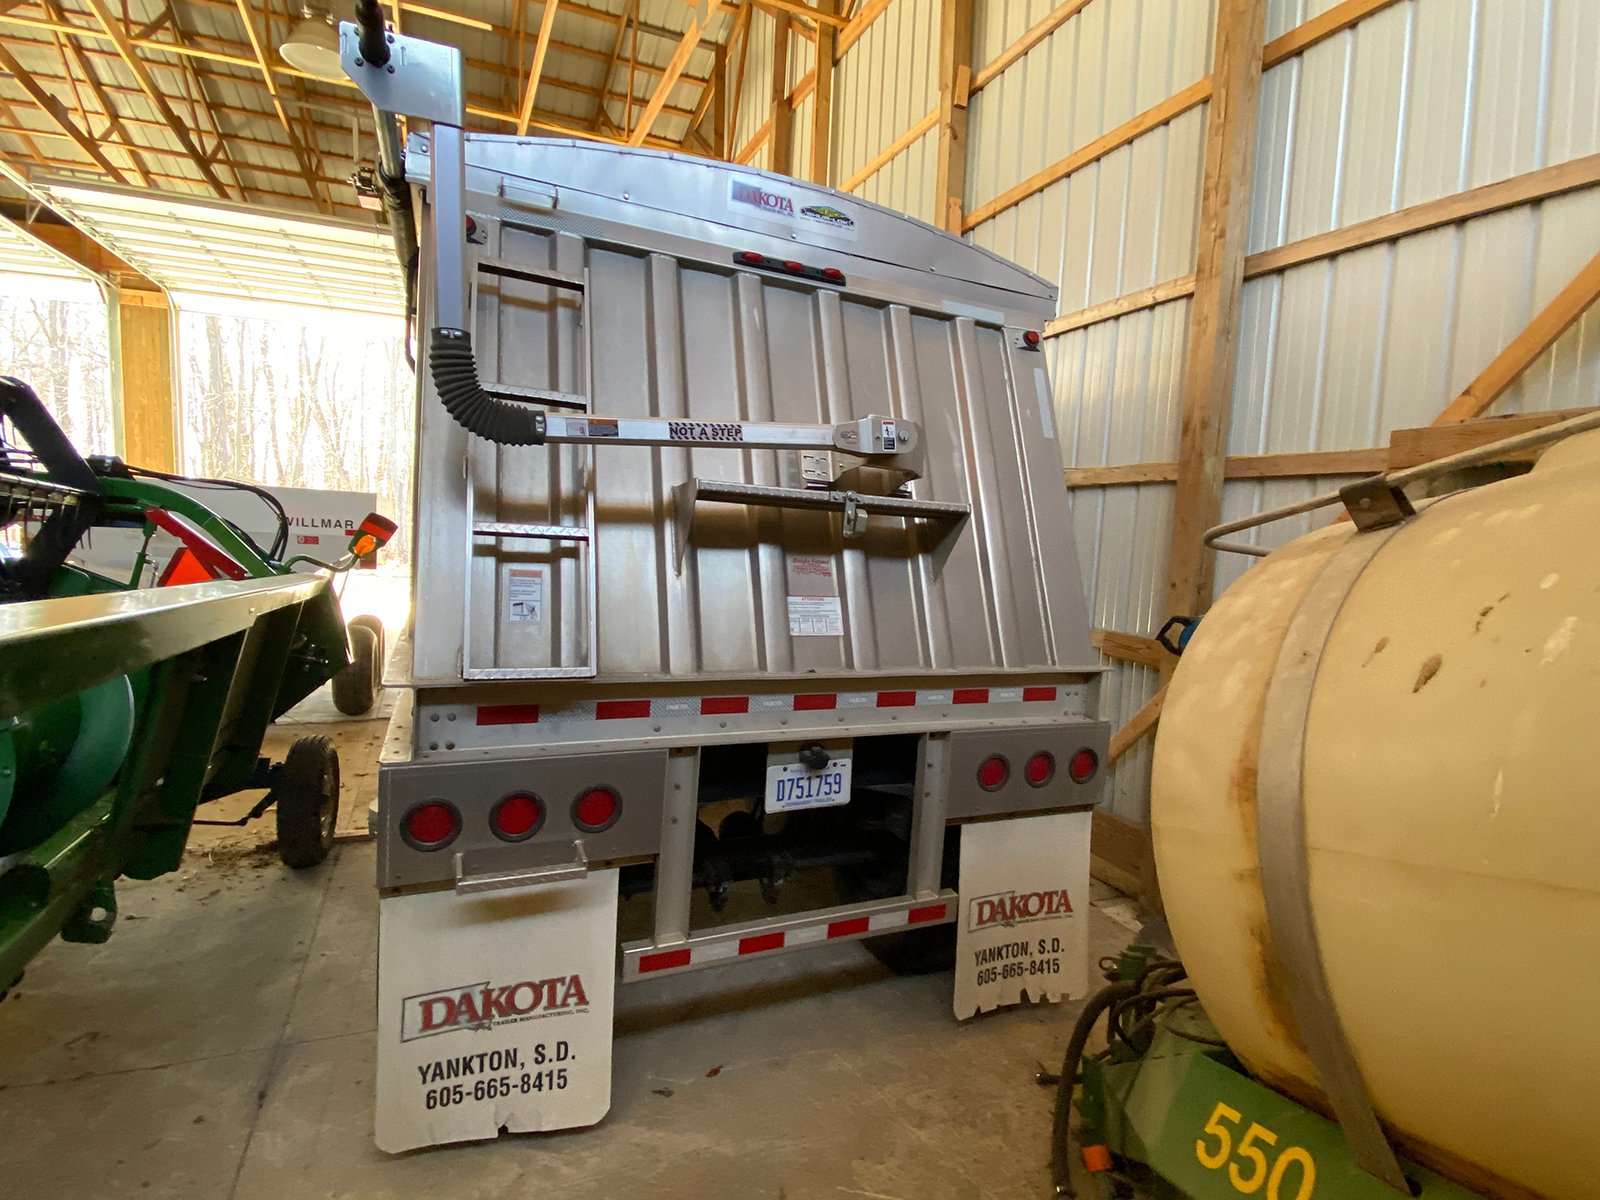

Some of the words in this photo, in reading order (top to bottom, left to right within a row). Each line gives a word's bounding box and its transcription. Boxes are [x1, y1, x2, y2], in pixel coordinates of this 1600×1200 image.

[738, 187, 794, 213] DAKOTA
[669, 426, 695, 437] NOT
[700, 427, 708, 437] A
[711, 427, 742, 438] STEP
[776, 772, 842, 802] D751759
[976, 889, 1073, 926] DAKOTA
[974, 941, 1033, 967] YANKTON,
[1038, 937, 1065, 955] S.D.
[977, 958, 1060, 987] 605-665-8415
[419, 974, 590, 1033] DAKOTA
[418, 1048, 525, 1085] YANKTON,
[534, 1040, 576, 1065] S.D.
[425, 1068, 568, 1110] 605-665-8415
[1195, 1101, 1316, 1200] 550
